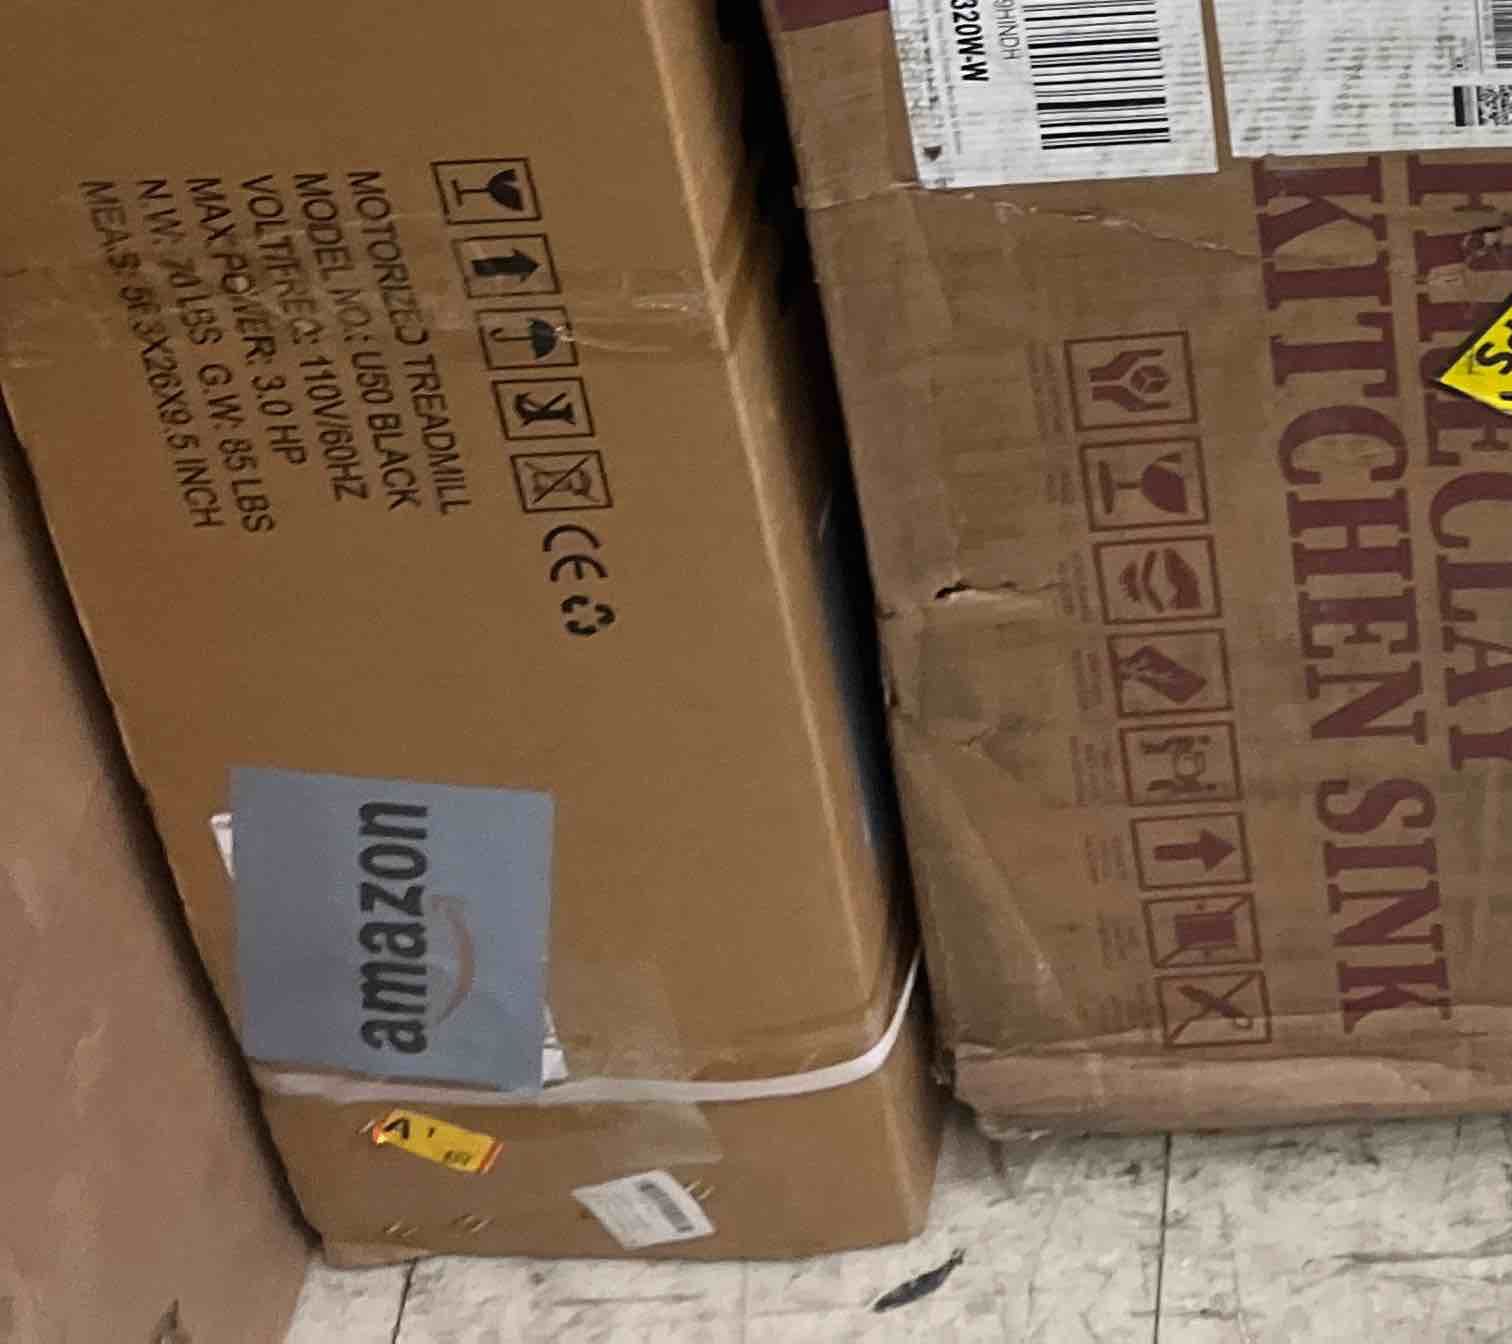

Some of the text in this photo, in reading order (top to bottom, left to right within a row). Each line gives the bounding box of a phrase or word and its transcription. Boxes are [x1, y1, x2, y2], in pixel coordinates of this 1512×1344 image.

[185, 177, 236, 245] MAX
[294, 173, 355, 281] MODEL
[176, 291, 223, 345] LBS
[347, 170, 472, 515] MOTORIZED TREADMILL
[251, 375, 293, 417] 3.0
[351, 351, 394, 405] U50
[218, 437, 257, 473] 85
[266, 423, 307, 466] HP
[300, 355, 370, 500] 110V/60HZ
[367, 413, 421, 510] BLACK
[1252, 155, 1428, 746] KITCHEN
[173, 457, 224, 529] INCH
[231, 476, 275, 533] LBS
[356, 800, 428, 1056] amazon
[1314, 777, 1453, 1035] SINK
